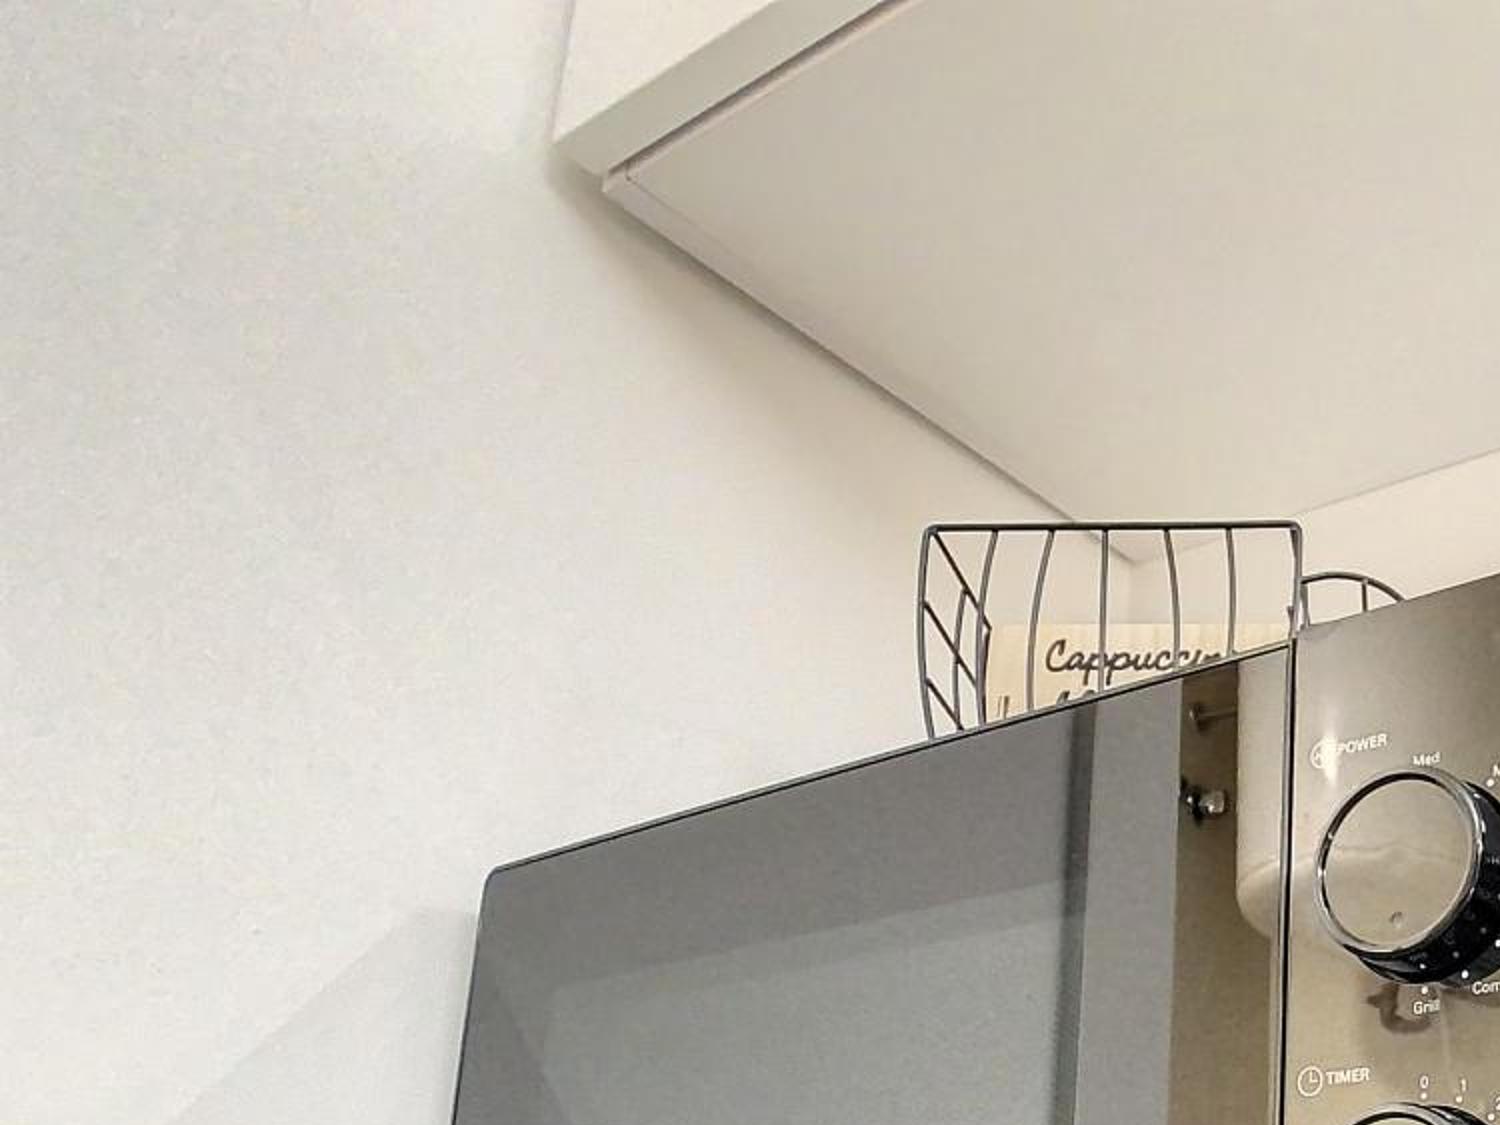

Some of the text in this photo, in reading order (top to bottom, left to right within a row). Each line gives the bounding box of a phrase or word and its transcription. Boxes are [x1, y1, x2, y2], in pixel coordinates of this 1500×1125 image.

[1412, 751, 1441, 767] Med
[1325, 1067, 1370, 1085] TIMER
[1419, 1075, 1430, 1089] 0
[1460, 1078, 1467, 1092] 1
